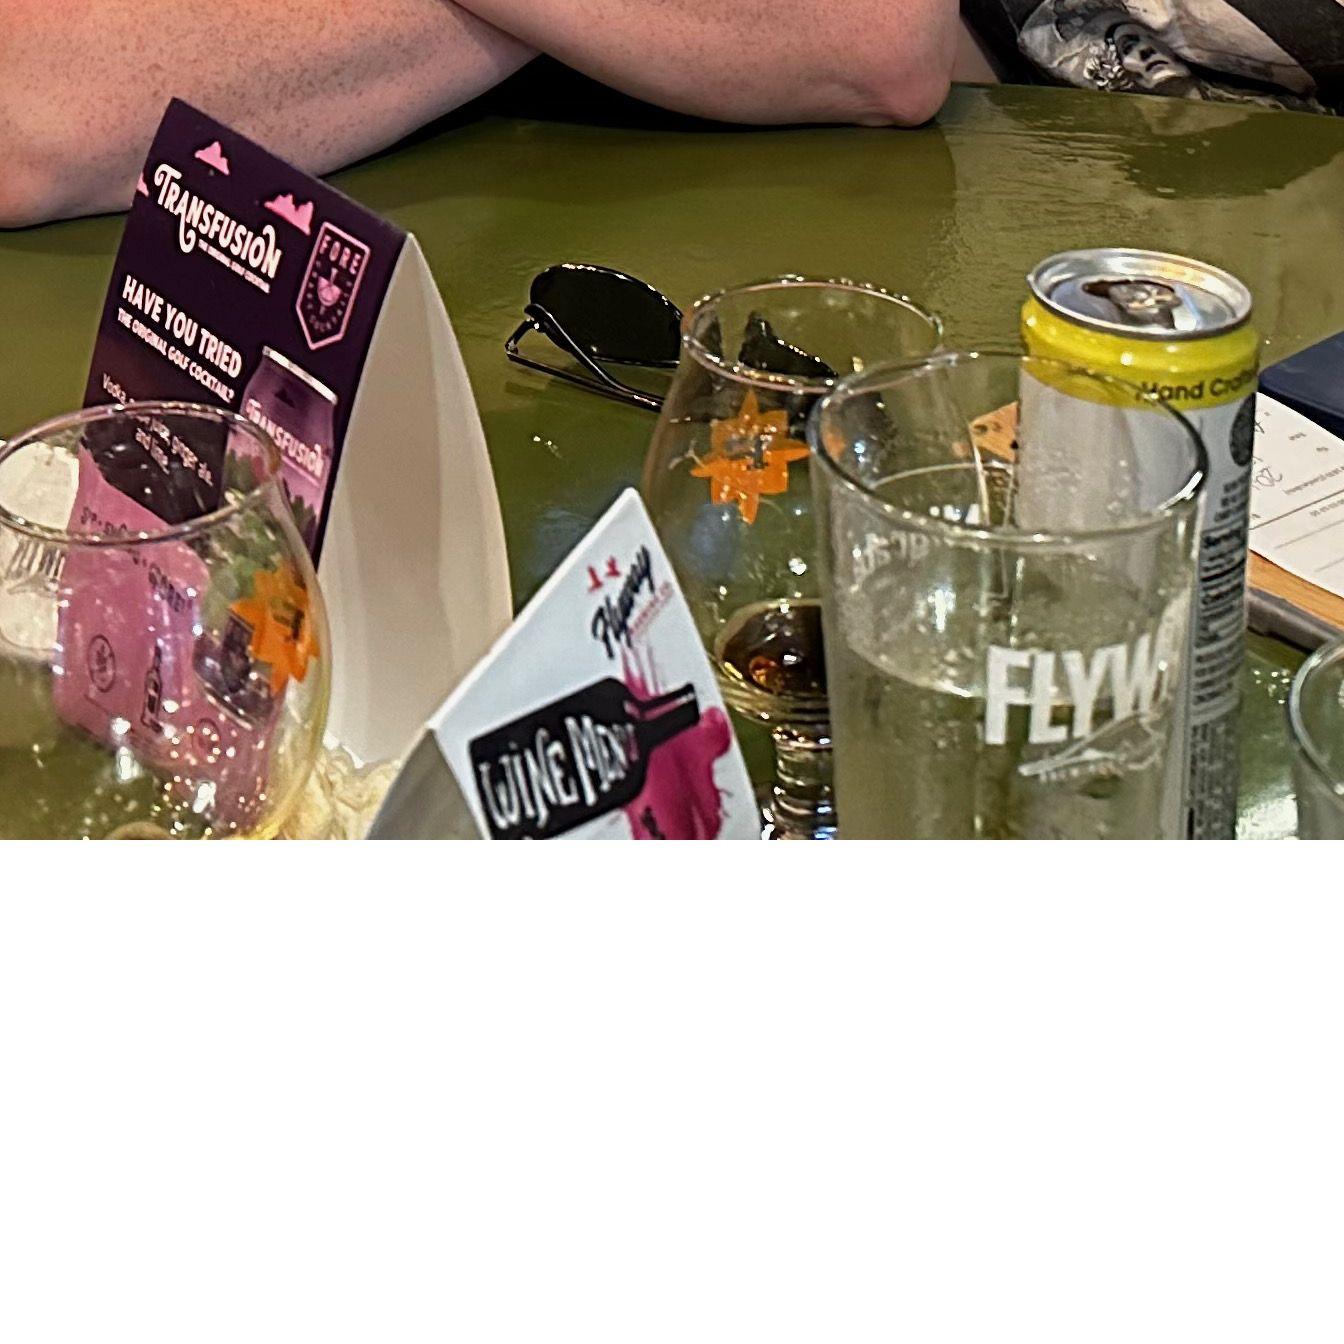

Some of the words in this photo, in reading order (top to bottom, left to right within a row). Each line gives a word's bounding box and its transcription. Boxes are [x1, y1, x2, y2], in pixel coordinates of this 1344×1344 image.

[319, 234, 362, 275] FORE
[118, 307, 133, 329] THE
[131, 319, 167, 356] ORIGINAL
[167, 346, 191, 371] GOLF
[122, 275, 164, 322] HAVE
[164, 303, 198, 347] YOU
[198, 327, 242, 379] TRIED
[984, 633, 1169, 746] FLYW
[478, 726, 580, 830] WINE
